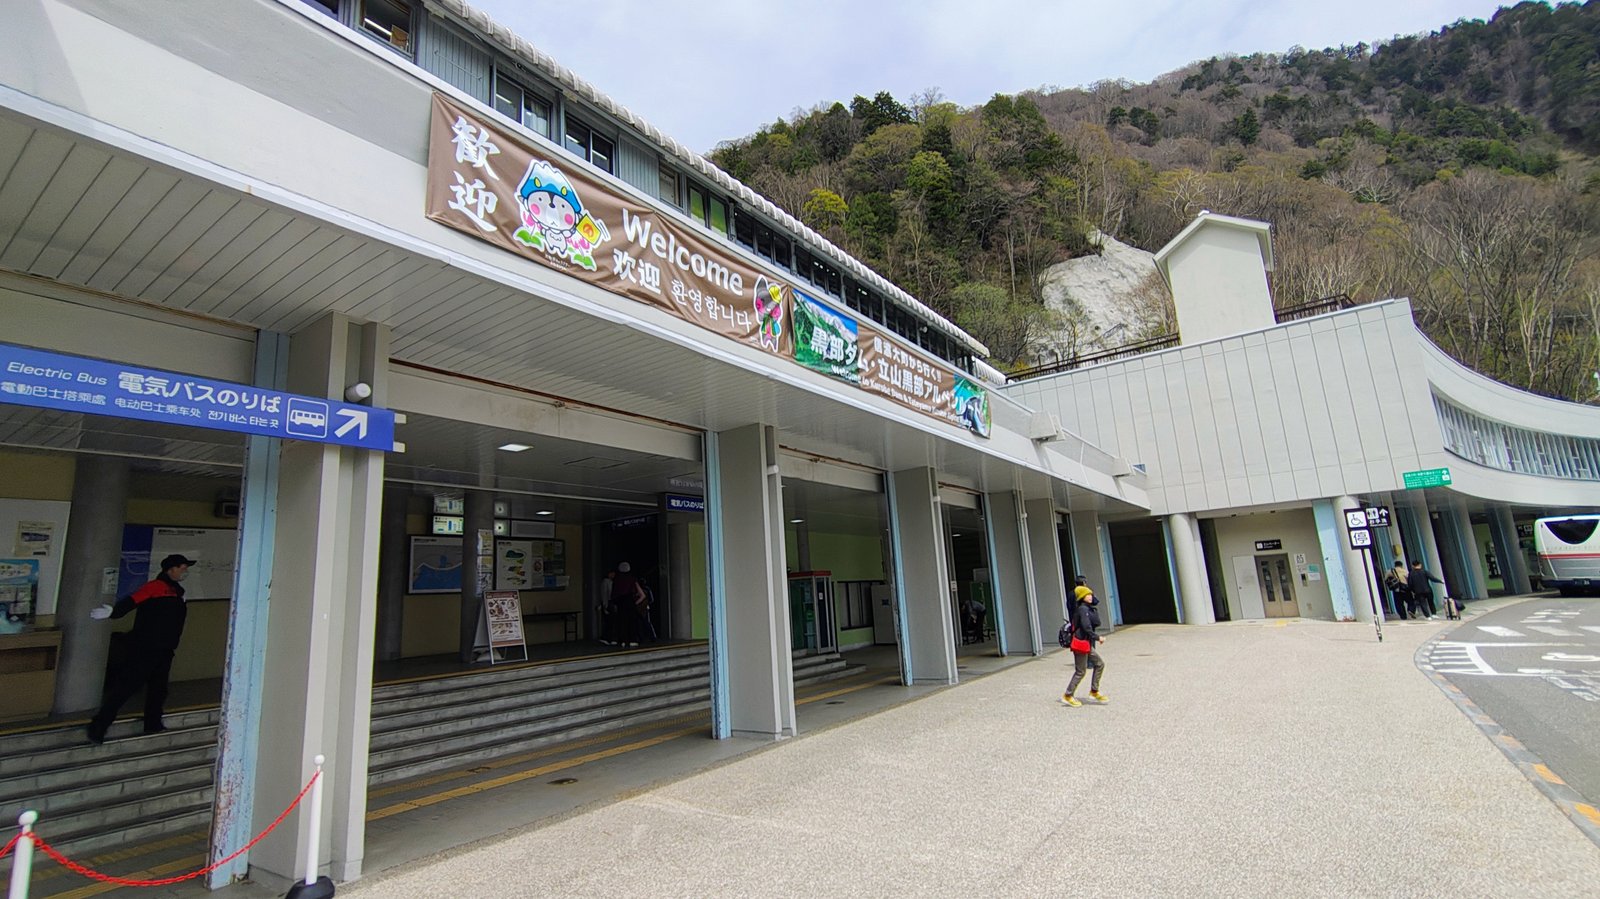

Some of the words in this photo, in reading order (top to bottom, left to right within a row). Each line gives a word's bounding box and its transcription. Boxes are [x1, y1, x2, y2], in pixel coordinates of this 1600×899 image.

[447, 115, 501, 232] 歓迎
[613, 248, 662, 294] 欢迎
[622, 207, 743, 296] Welcome
[671, 278, 752, 333] 환영합니다
[7, 361, 73, 380] Electric
[77, 372, 108, 386] Bus
[118, 371, 282, 413] 電気バスのりば
[114, 397, 201, 418] 电动巴士乘车处
[208, 410, 227, 421] 전기
[228, 414, 247, 424] 버스
[249, 416, 268, 427] 타는
[269, 419, 279, 428] 곳
[1354, 532, 1368, 545] 停
